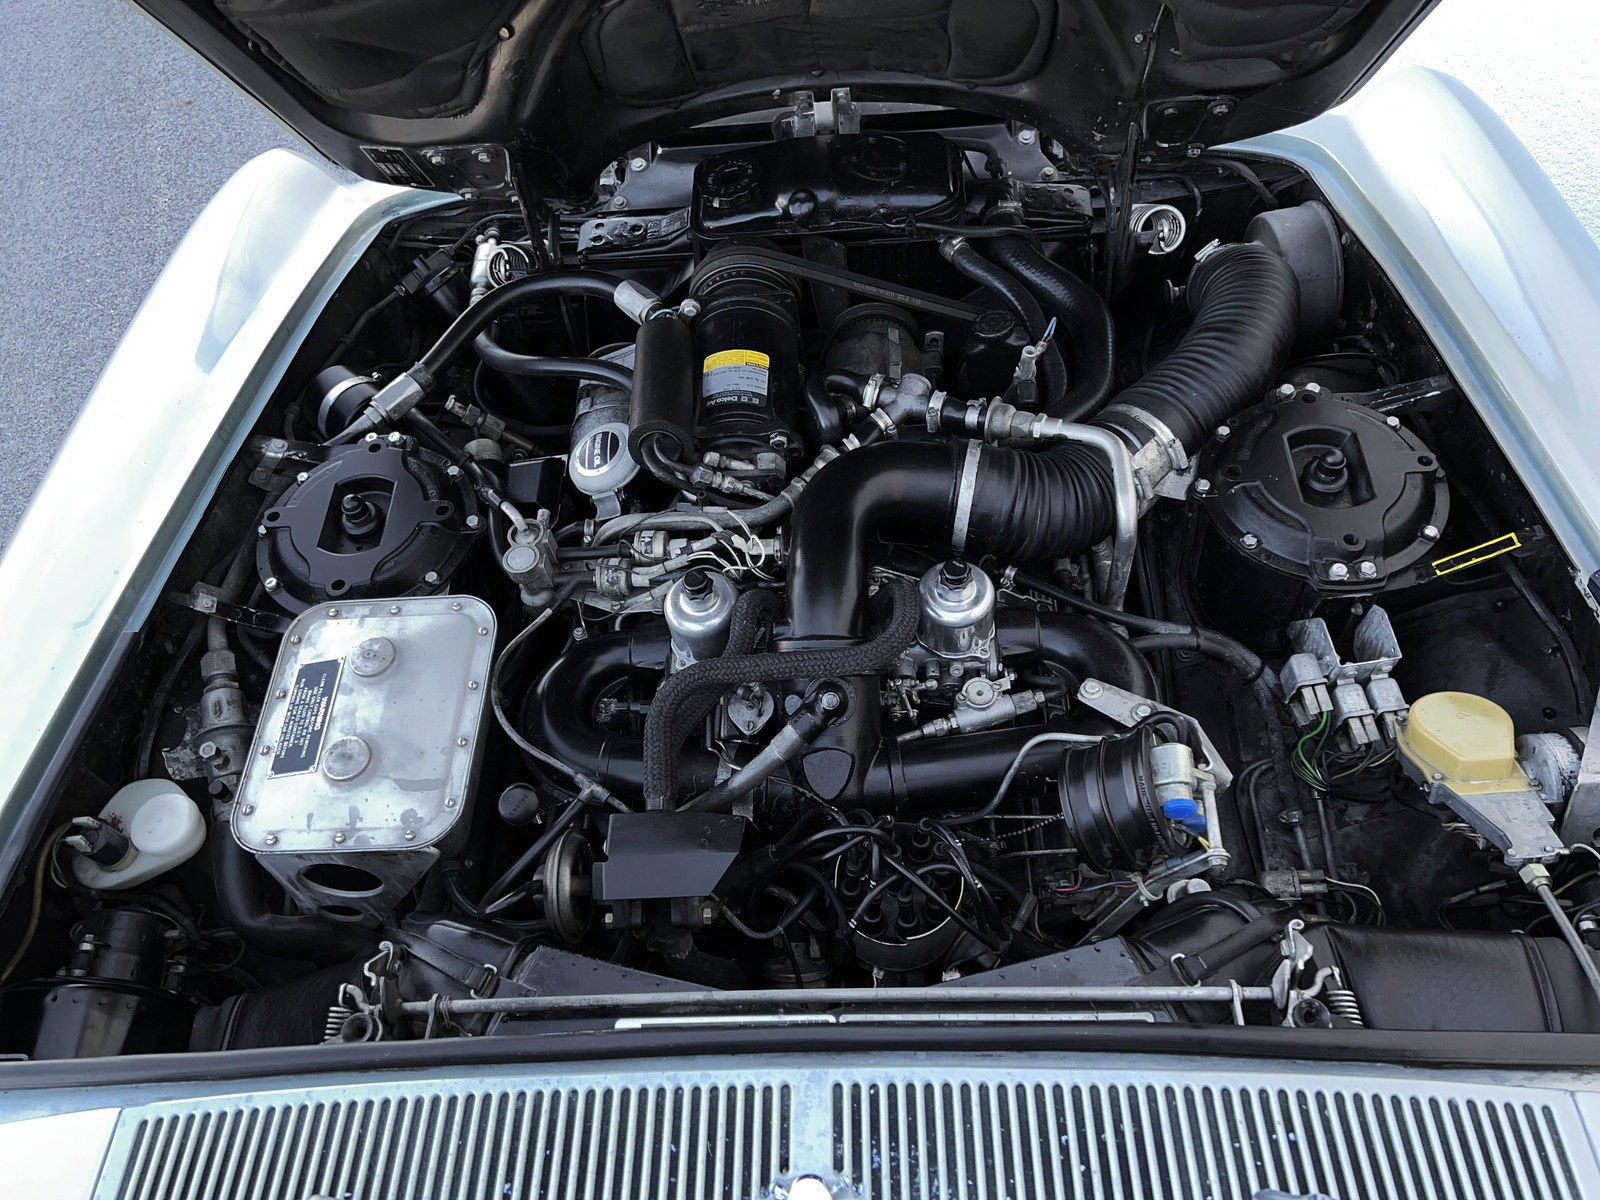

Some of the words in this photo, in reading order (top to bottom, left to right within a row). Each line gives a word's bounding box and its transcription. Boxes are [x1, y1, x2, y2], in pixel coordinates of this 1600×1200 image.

[594, 433, 602, 455] ENGINE
[289, 684, 299, 703] TOPPING
[294, 689, 303, 704] ENGINE
[295, 705, 303, 721] SEALED
[303, 708, 312, 728] CASTROL
[314, 696, 328, 730] WARNING
[285, 720, 294, 740] MINUTES
[307, 716, 316, 732] BEFORE
[280, 741, 288, 759] BEFORE
[509, 794, 529, 816] ENGINE
